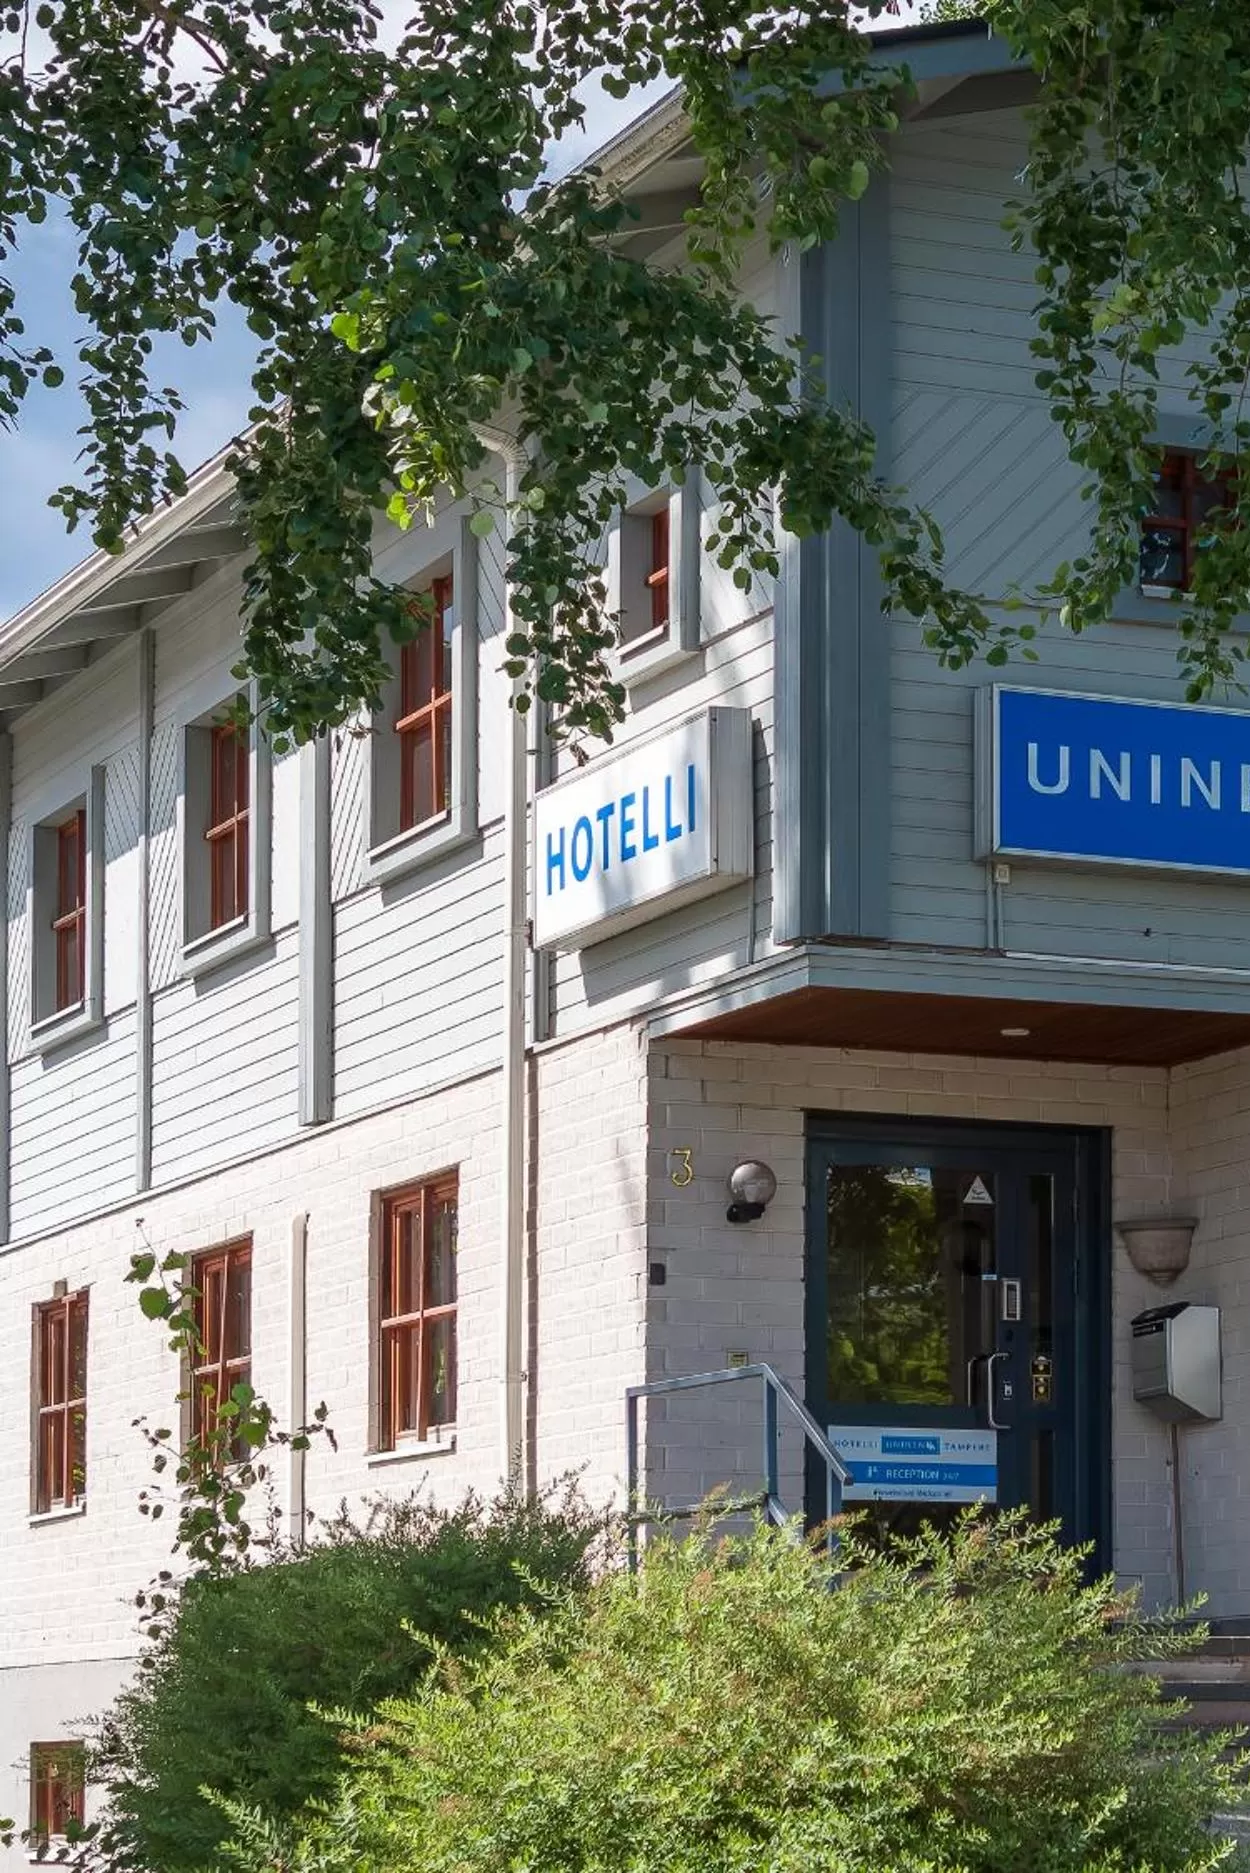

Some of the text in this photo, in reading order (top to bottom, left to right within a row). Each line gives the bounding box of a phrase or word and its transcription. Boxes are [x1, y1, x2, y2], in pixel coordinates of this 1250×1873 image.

[546, 763, 696, 896] HOTELLI
[672, 1148, 693, 1187] 3
[886, 1469, 939, 1479] RECEPTION
